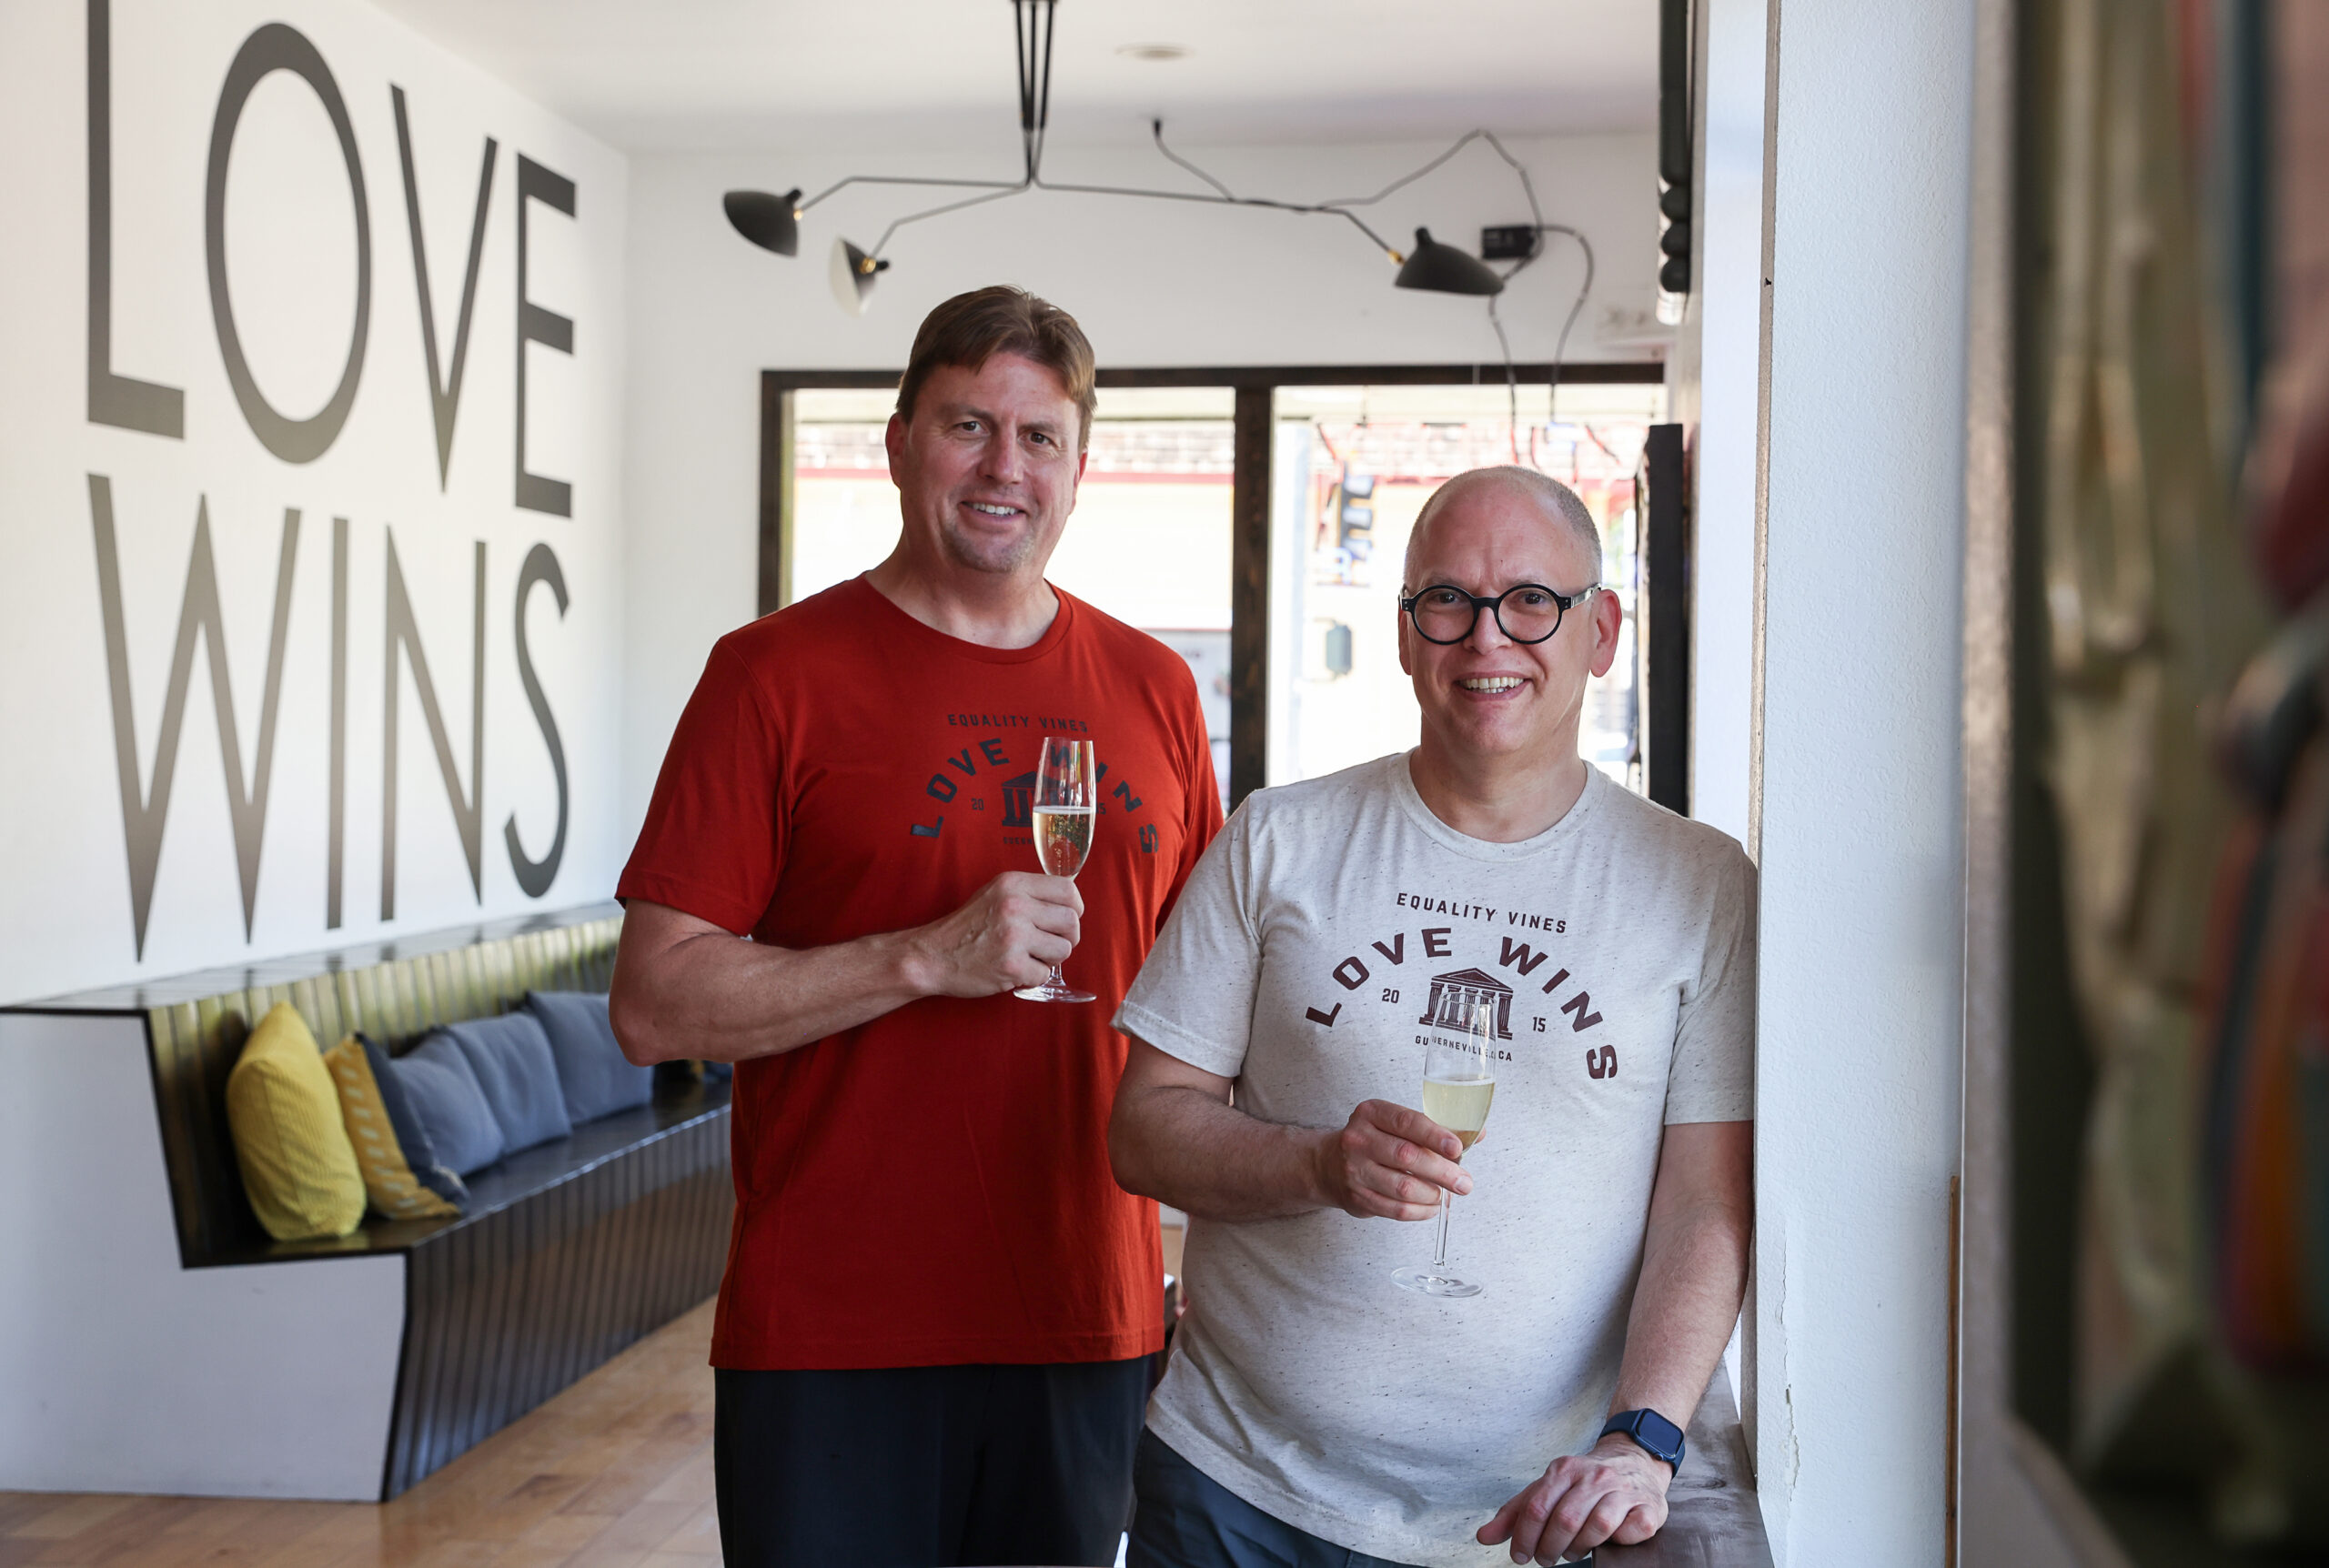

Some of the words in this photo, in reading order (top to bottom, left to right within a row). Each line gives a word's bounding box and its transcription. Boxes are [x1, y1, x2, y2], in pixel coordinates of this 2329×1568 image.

[87, 0, 577, 518] LOVE
[87, 473, 570, 962] WINS
[948, 714, 1030, 728] EQUALITY
[1039, 717, 1088, 733] VINES
[911, 738, 1010, 839] LOVE
[971, 798, 985, 811] 20
[1396, 892, 1497, 922] EQUALITY
[1508, 911, 1567, 934] VINES
[1306, 927, 1453, 1028] LOVE
[1498, 936, 1618, 1080] WINS
[1382, 988, 1400, 1004] 20
[1532, 1016, 1547, 1033] 15
[1498, 1050, 1513, 1062] CA
